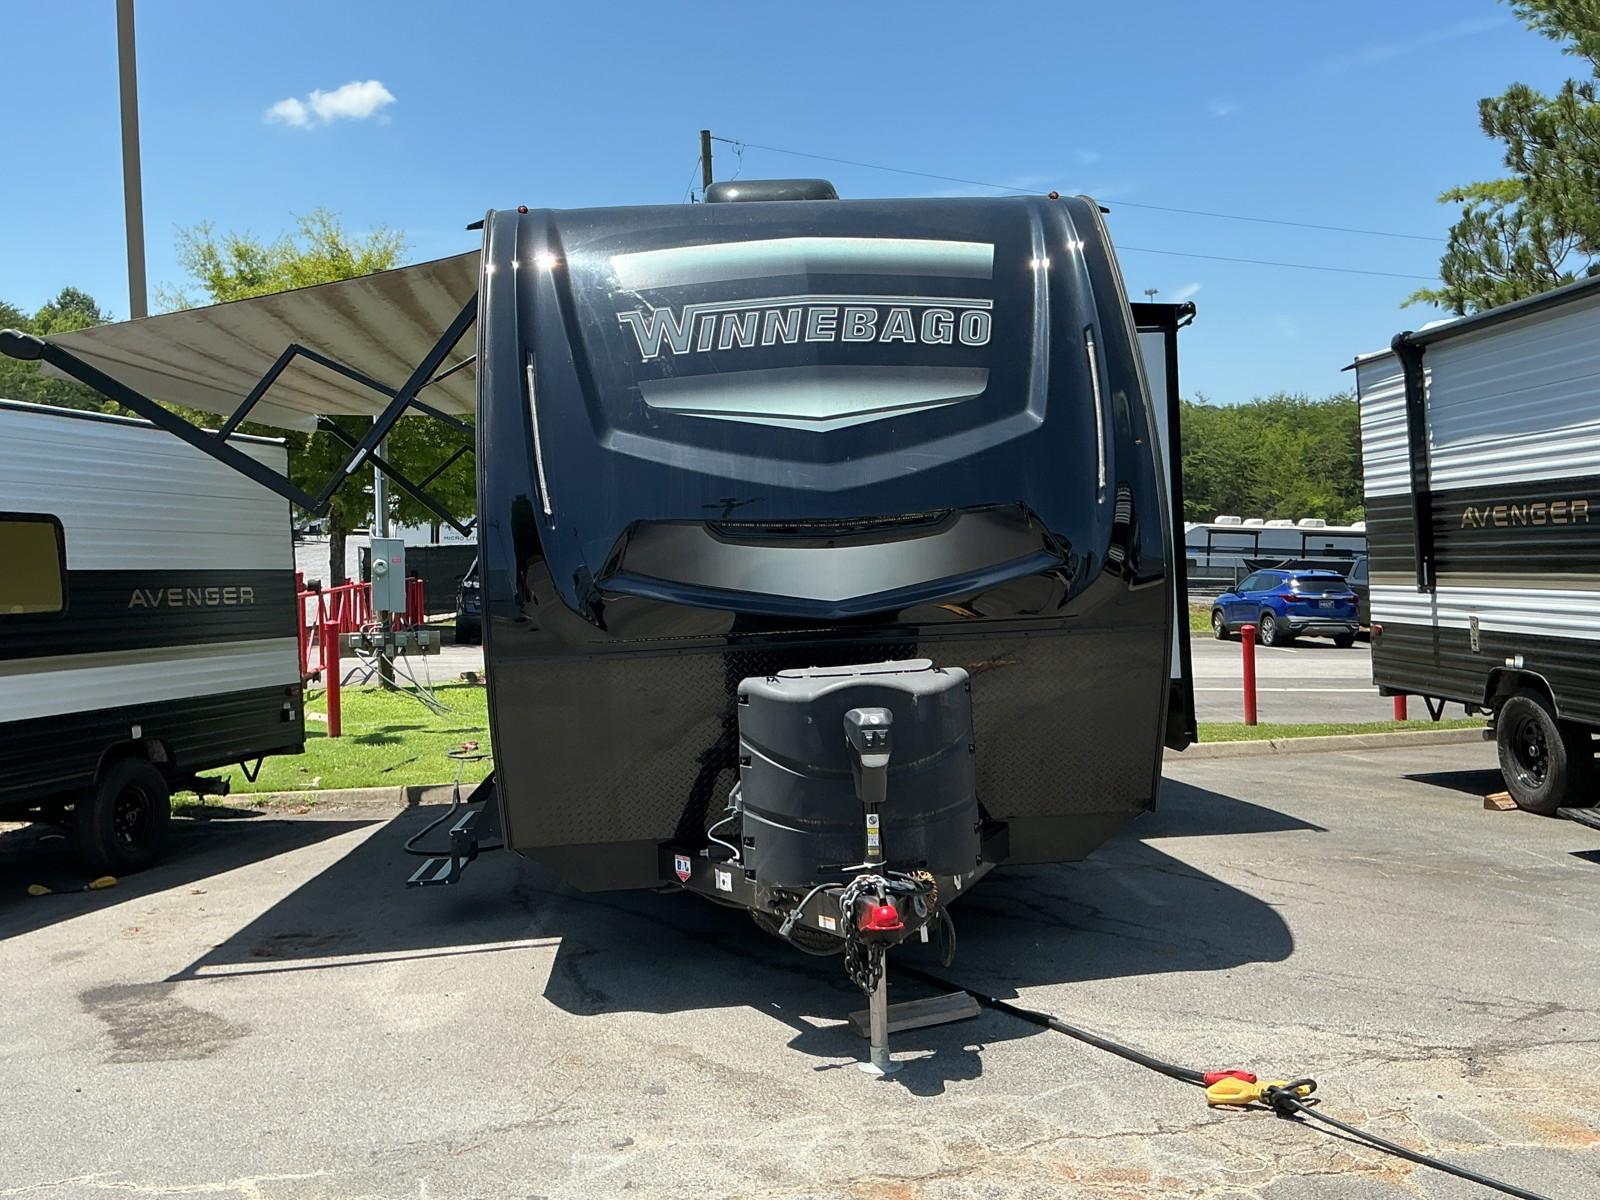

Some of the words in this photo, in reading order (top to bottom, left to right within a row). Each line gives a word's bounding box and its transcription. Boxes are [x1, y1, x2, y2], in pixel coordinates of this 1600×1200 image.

[617, 295, 993, 359] WINNEBAGO
[1461, 500, 1590, 528] AVENGER
[128, 587, 254, 608] AVENGER
